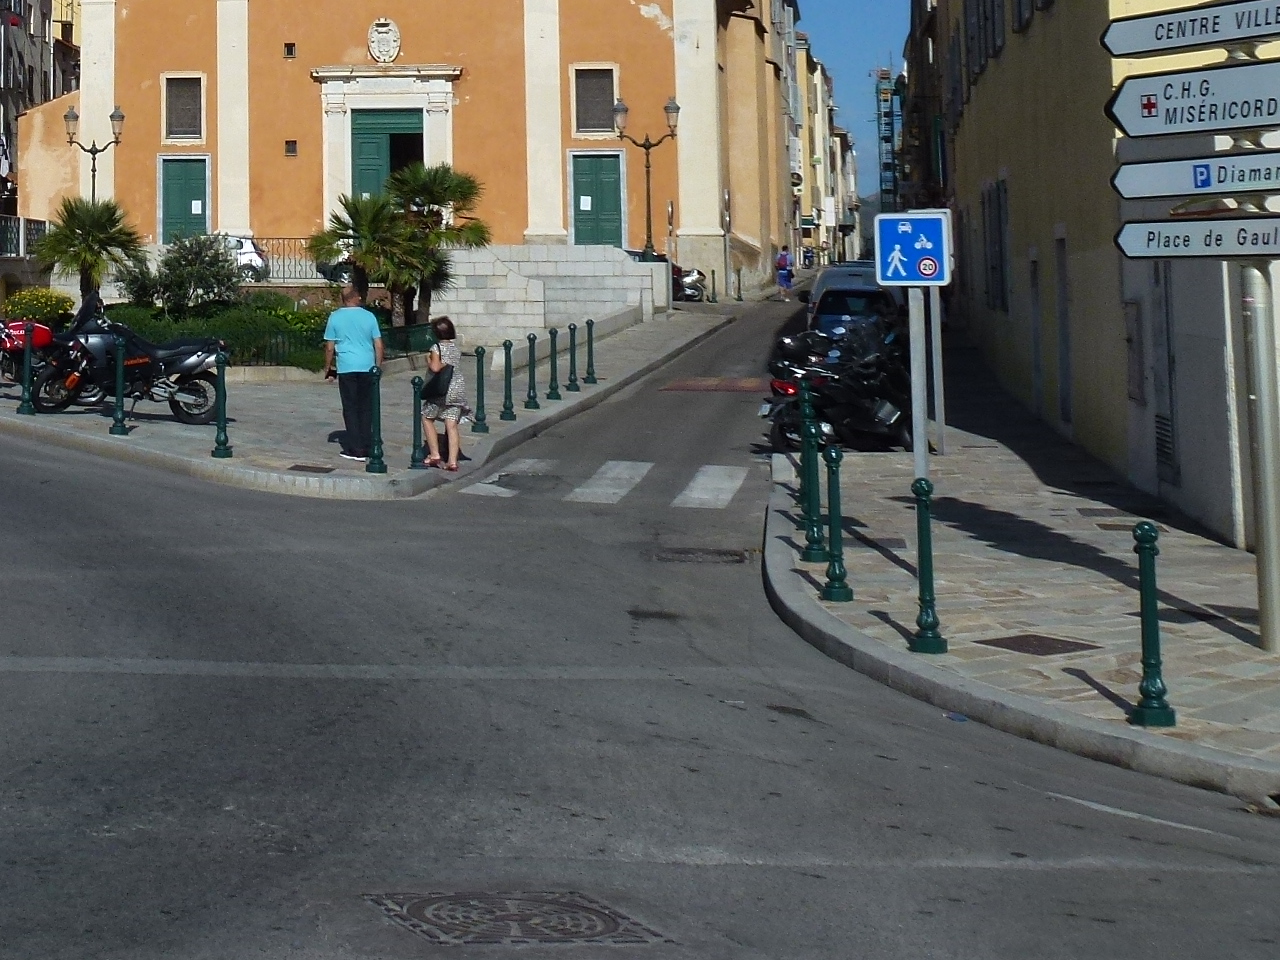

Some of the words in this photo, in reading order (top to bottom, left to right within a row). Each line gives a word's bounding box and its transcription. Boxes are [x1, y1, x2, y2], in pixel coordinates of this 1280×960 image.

[1155, 15, 1220, 41] CENTRE
[1235, 6, 1280, 30] VILLE
[1163, 79, 1215, 100] C.H.G.
[1195, 167, 1208, 186] P
[1146, 230, 1191, 248] Place
[1204, 229, 1223, 247] de
[1237, 226, 1279, 246] Gaul
[922, 263, 934, 271] 20
